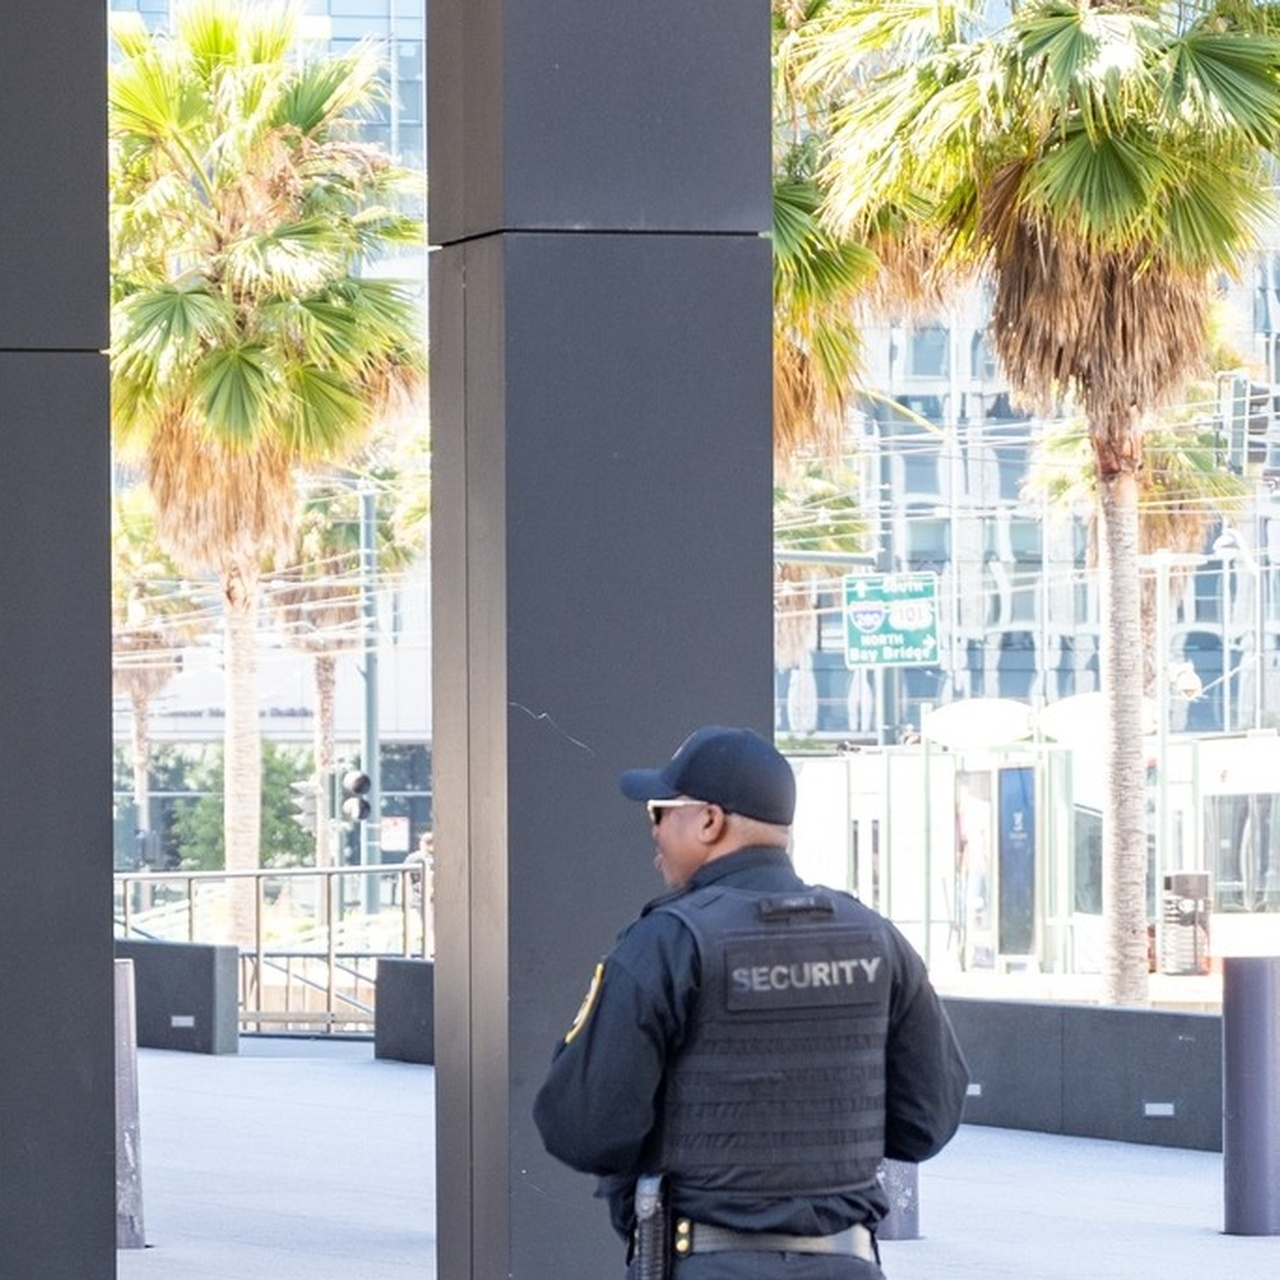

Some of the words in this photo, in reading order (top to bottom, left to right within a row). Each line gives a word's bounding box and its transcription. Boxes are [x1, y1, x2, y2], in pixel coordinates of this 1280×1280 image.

[860, 633, 904, 646] NORTH
[849, 647, 878, 661] Bay
[883, 645, 931, 661] Bridge
[732, 957, 882, 993] SECURITY
